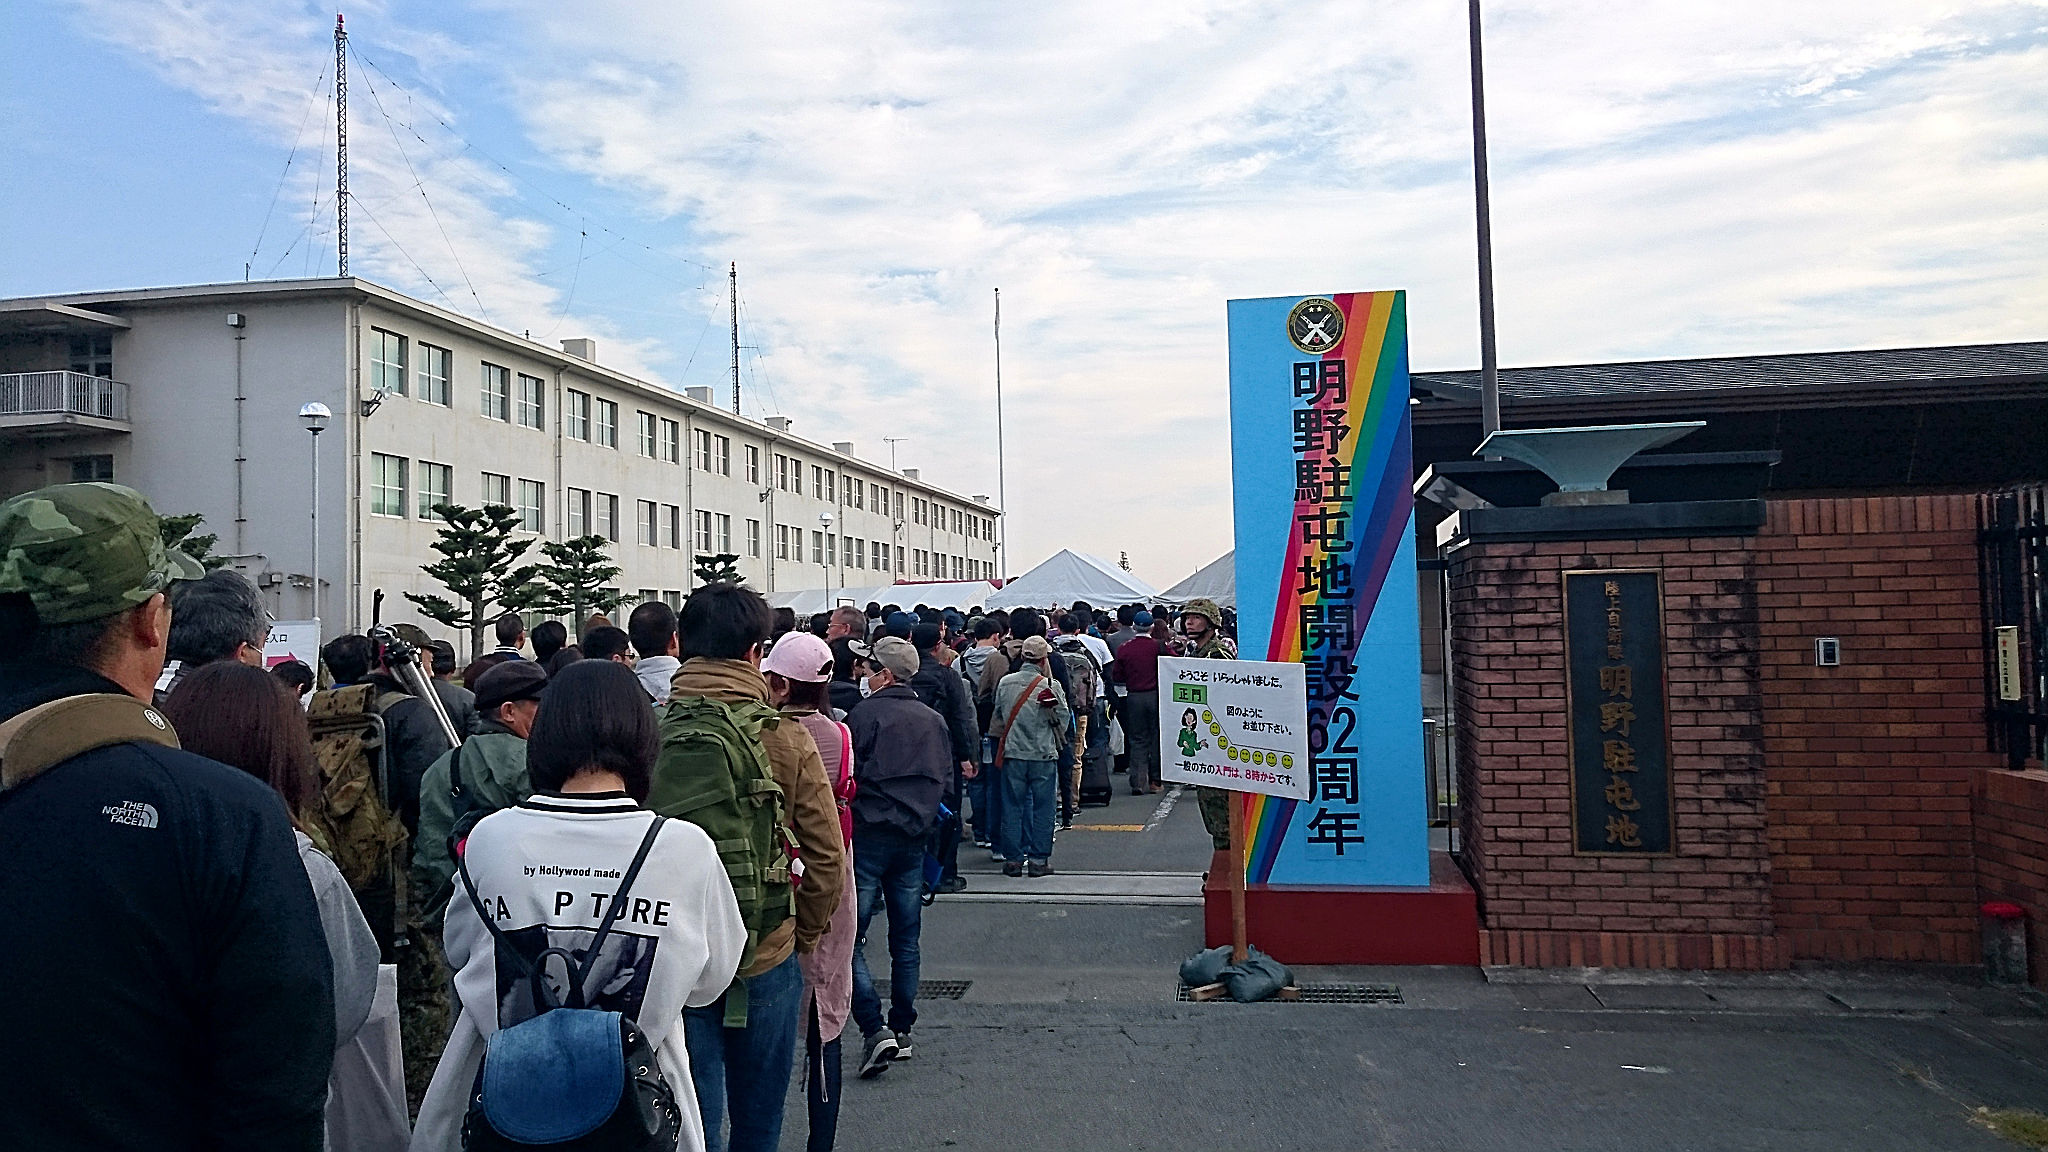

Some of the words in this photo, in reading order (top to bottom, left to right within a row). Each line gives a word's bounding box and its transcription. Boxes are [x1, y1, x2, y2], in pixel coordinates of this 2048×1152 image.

[1293, 359, 1365, 856] 明野駐屯地開設62周年
[1179, 669, 1208, 681] ようこそ
[1213, 672, 1283, 689] いらっしゃいました。
[1178, 687, 1202, 701] 正門
[1226, 705, 1263, 719] 図のように
[1242, 720, 1293, 736] お並び下さい。
[1599, 664, 1642, 847] 明野駐屯地
[1175, 760, 1296, 787] 一般の方の入門は、8時からです。
[102, 805, 141, 818] NORTH
[123, 800, 144, 810] THE
[110, 814, 138, 826] FACE
[524, 866, 536, 877] by
[539, 865, 591, 878] Hollywood
[594, 869, 621, 879] made
[554, 891, 574, 916] P
